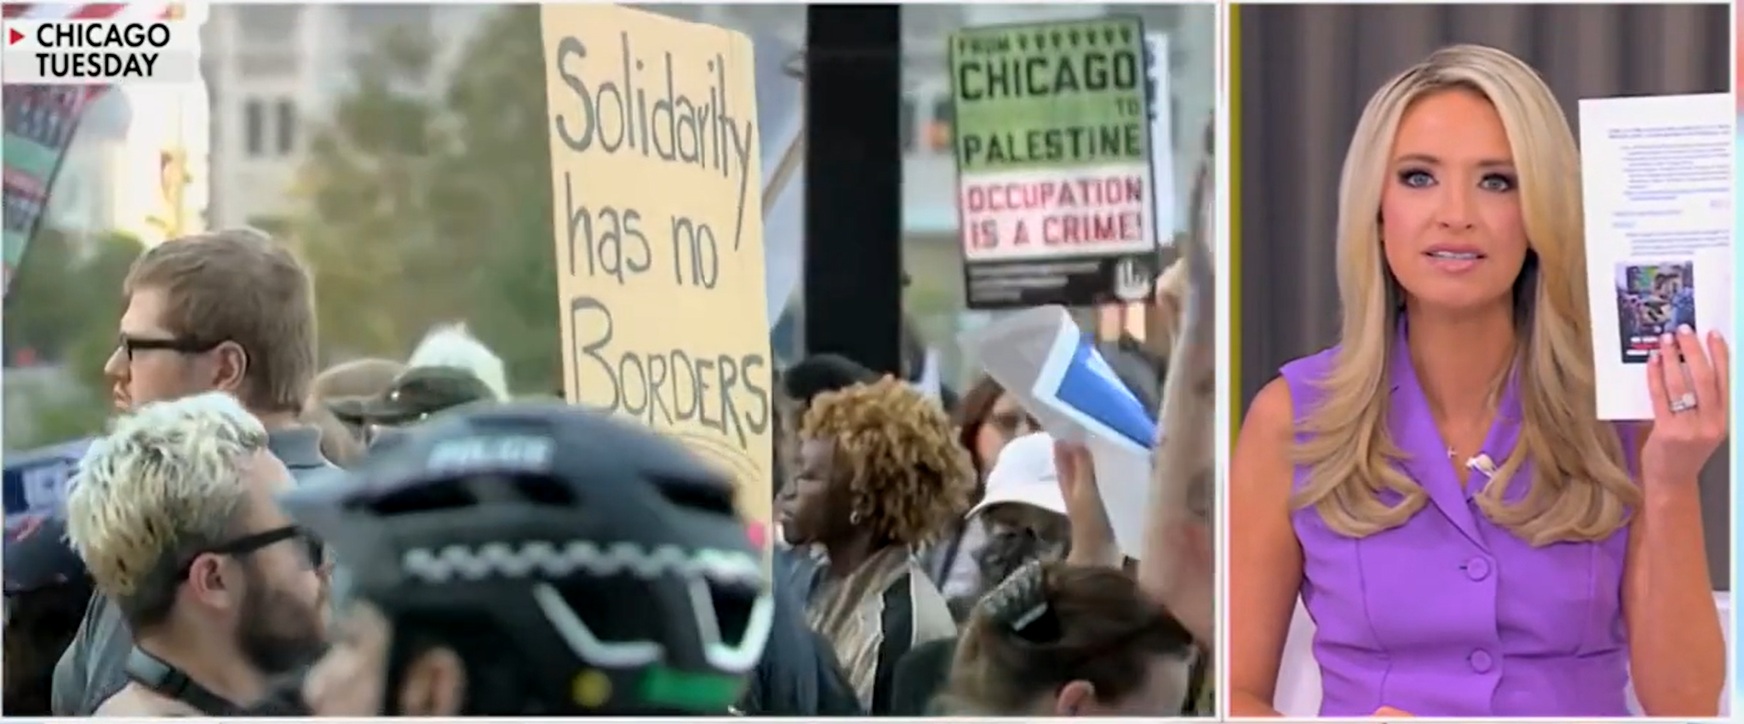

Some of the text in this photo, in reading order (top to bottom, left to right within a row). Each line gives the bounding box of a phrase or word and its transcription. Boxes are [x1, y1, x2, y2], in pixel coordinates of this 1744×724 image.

[959, 51, 1138, 101] CHICAGO
[1116, 97, 1140, 117] TO
[555, 31, 752, 251] Solidarity
[962, 122, 1142, 166] PALESTINE
[968, 174, 1143, 213] OCCUPATION
[565, 171, 719, 290] has no
[970, 211, 1143, 250] IS A CRIME!
